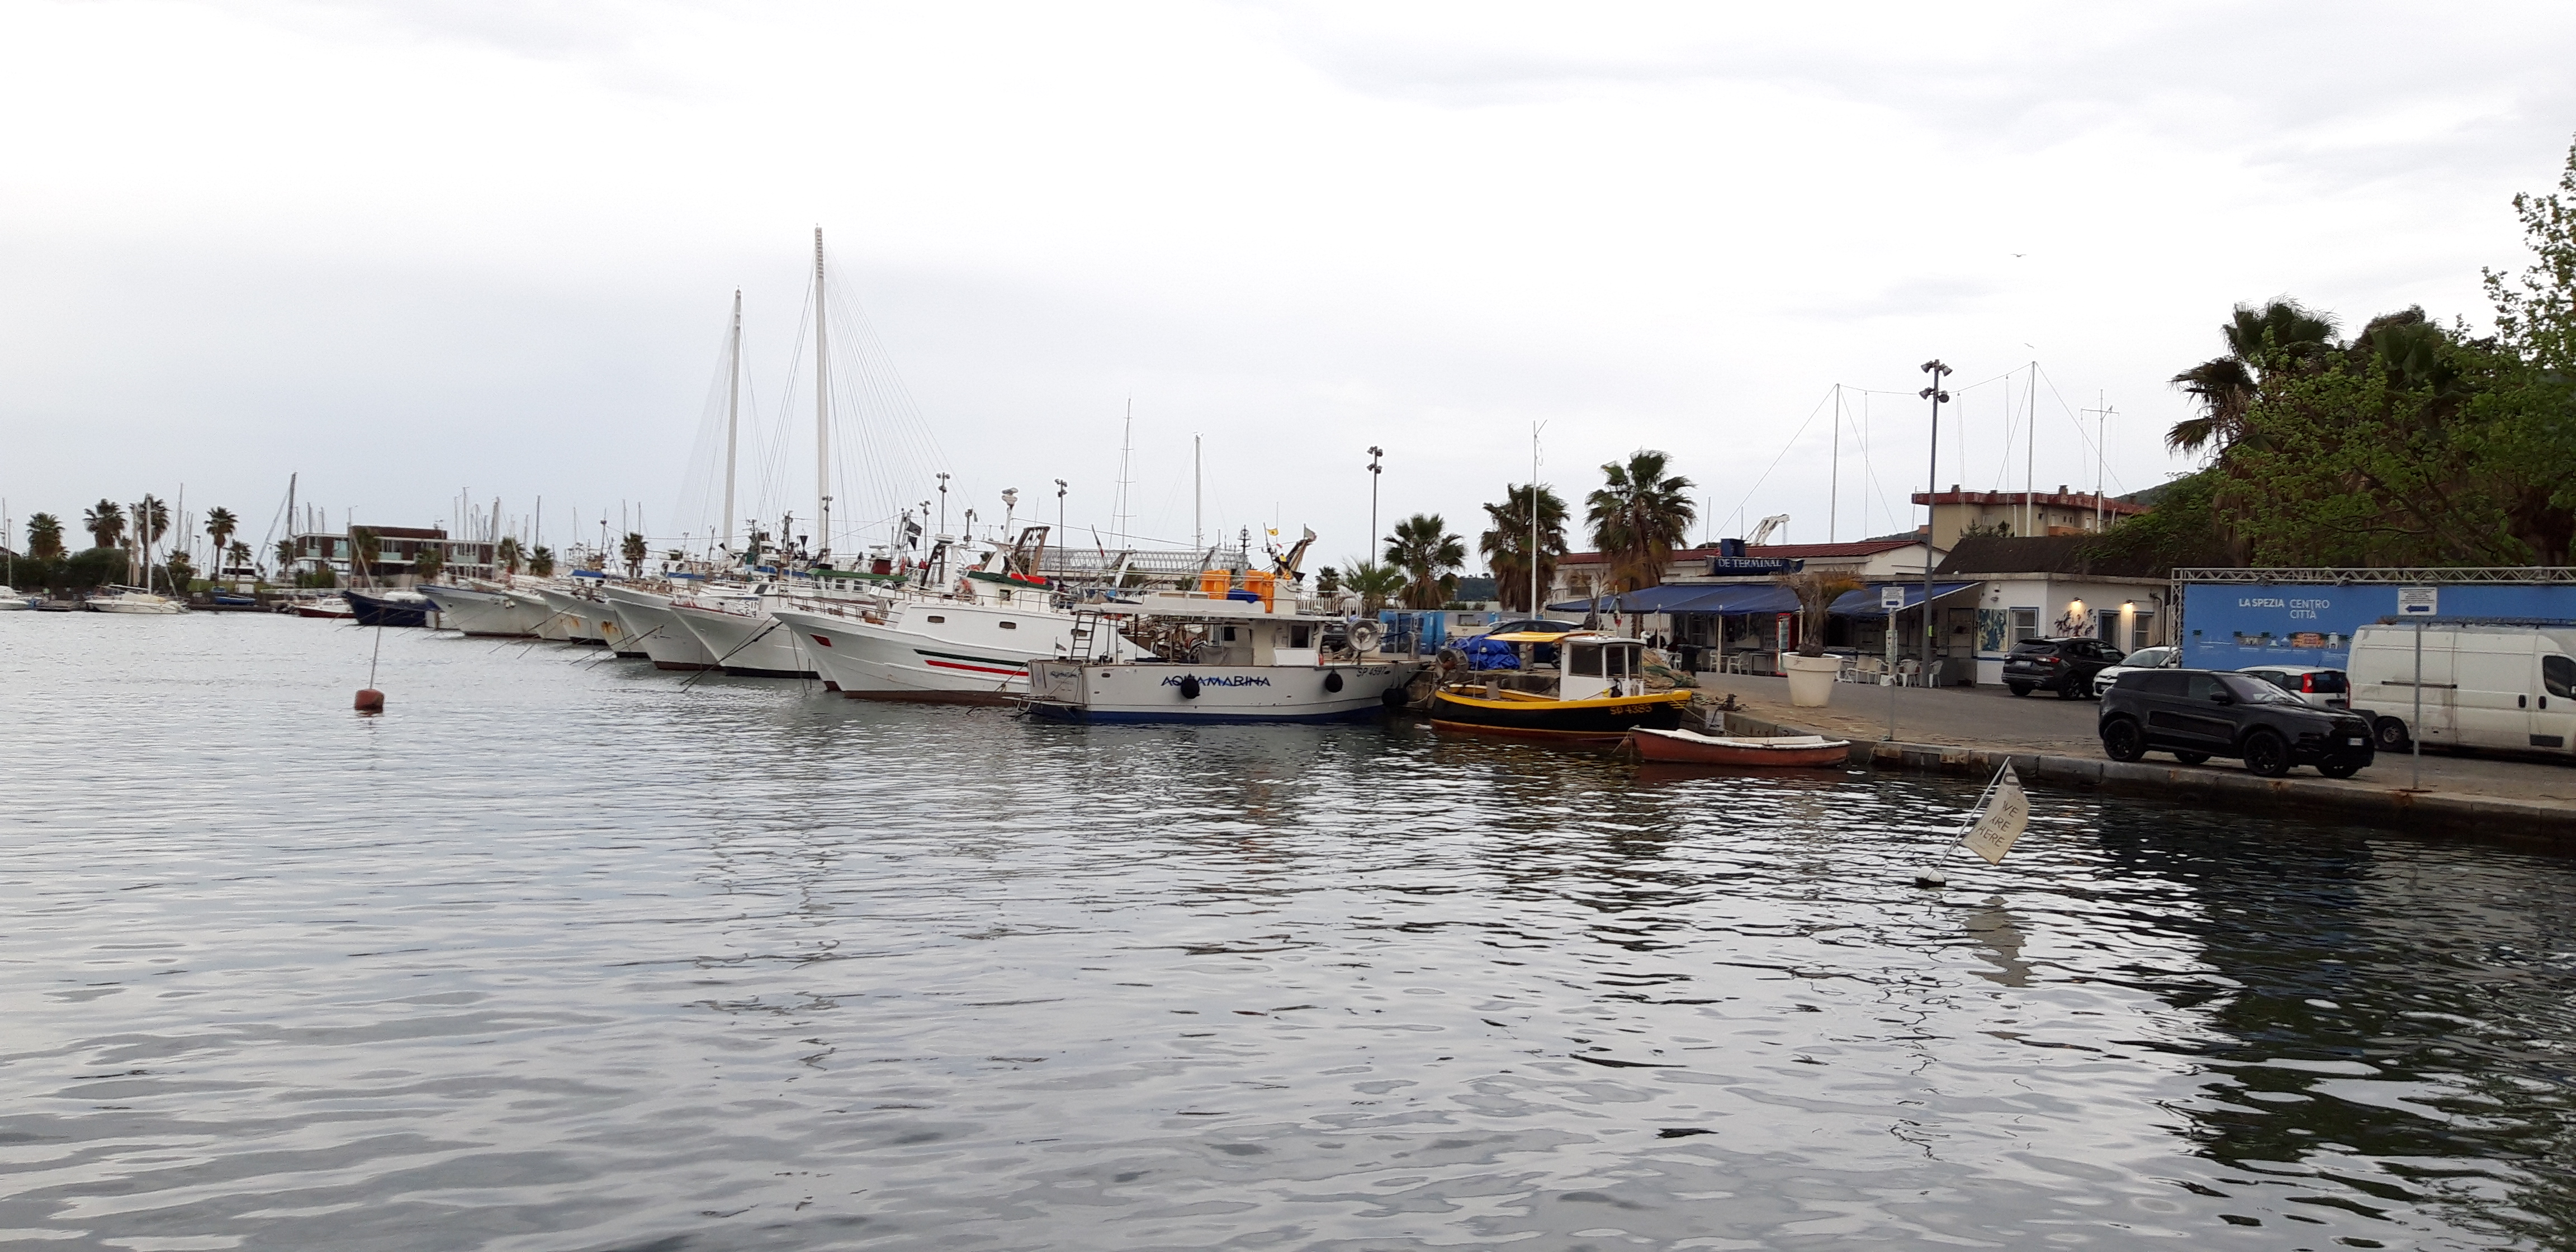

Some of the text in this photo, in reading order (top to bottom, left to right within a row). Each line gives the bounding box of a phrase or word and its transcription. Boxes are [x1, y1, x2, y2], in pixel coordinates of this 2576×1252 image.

[1734, 559, 1782, 568] TERMINAL
[2238, 598, 2330, 609] LA SPEZIA CENTRO
[1356, 667, 1368, 677] SP
[2002, 800, 2018, 817] WE
[1989, 815, 2011, 832] ARE
[1975, 826, 2005, 847] HERE
